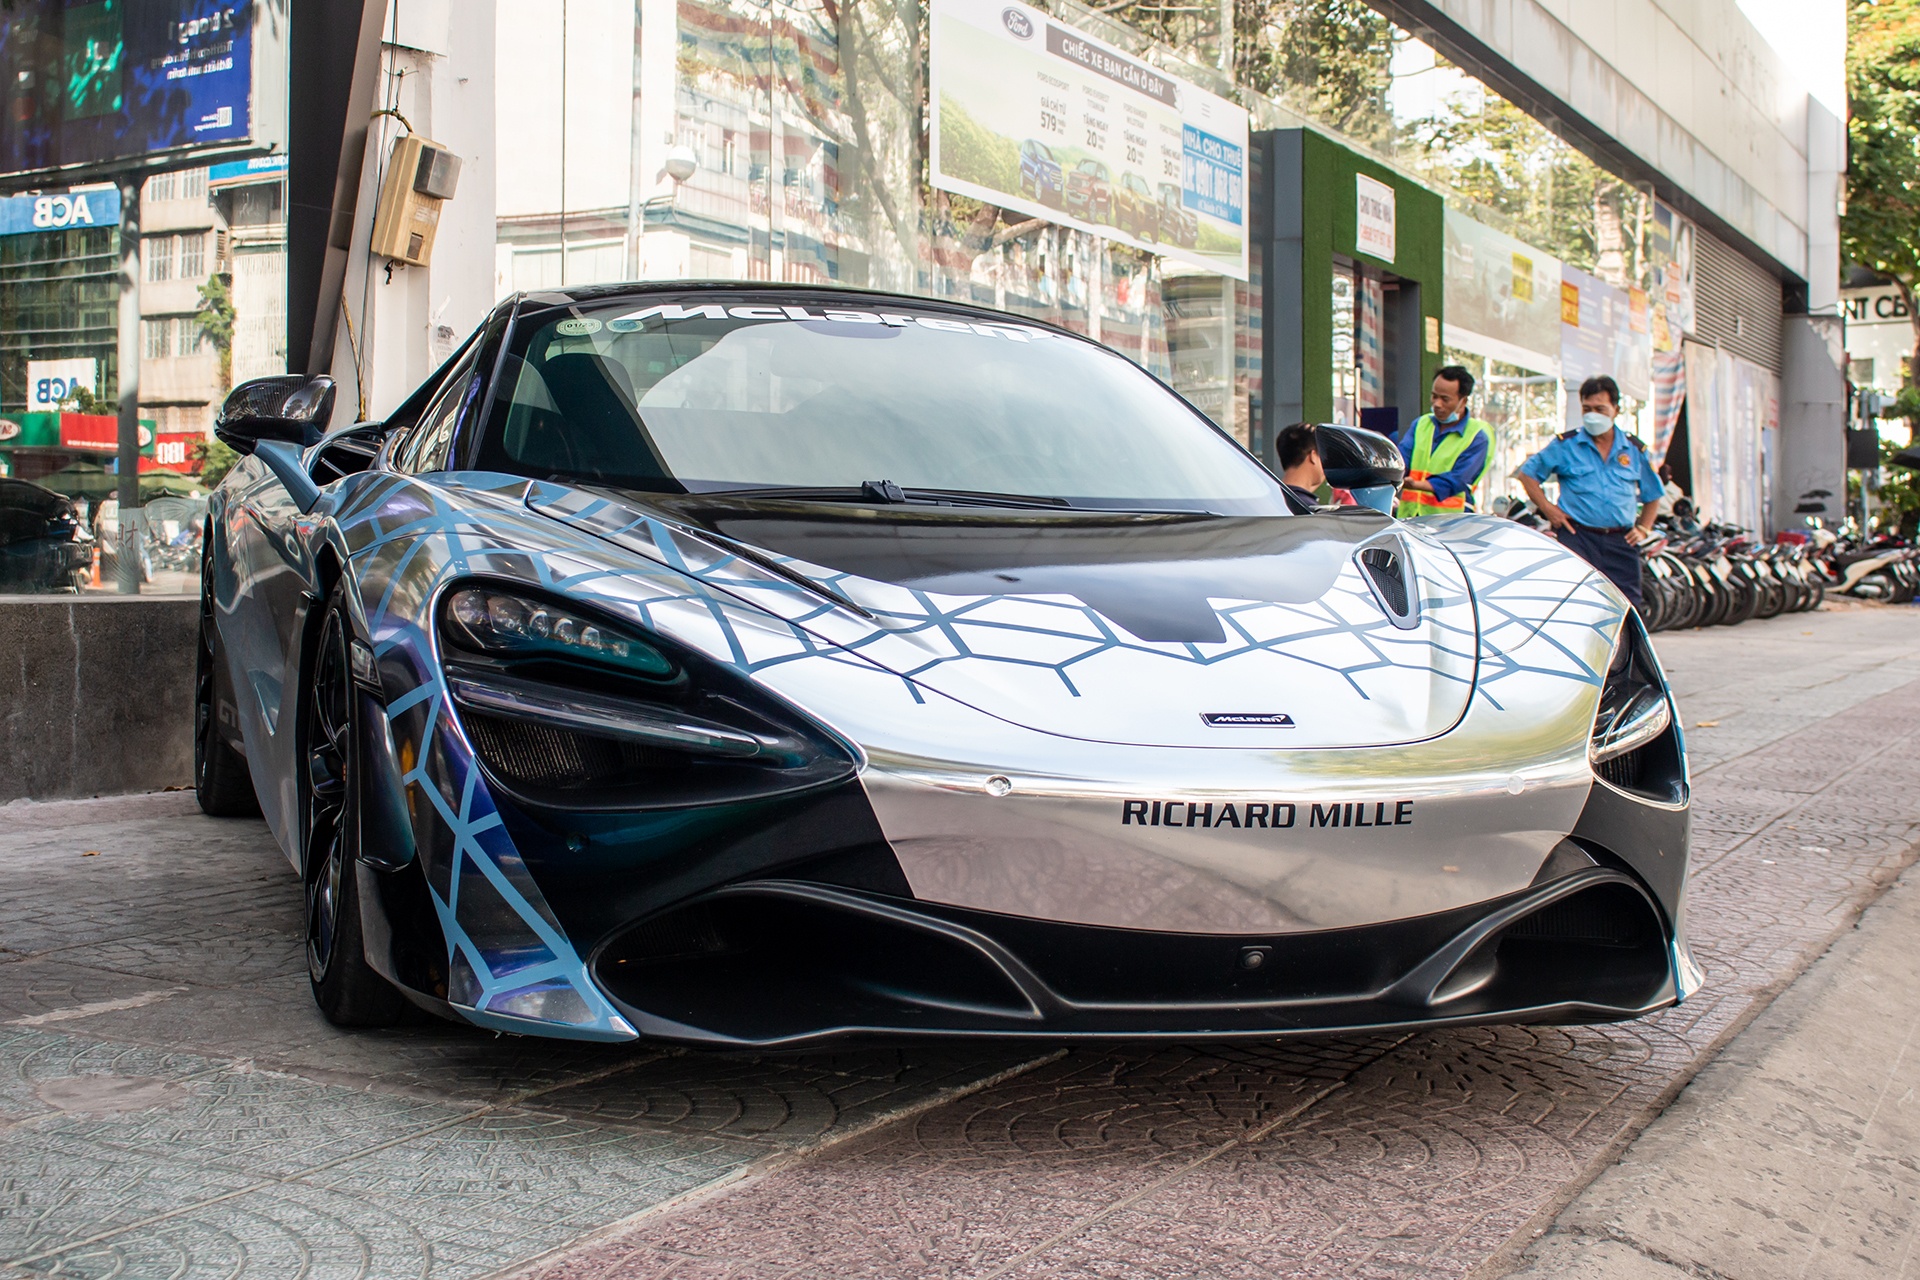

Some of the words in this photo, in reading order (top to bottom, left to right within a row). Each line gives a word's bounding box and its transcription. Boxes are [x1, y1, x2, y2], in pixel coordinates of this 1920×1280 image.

[1007, 12, 1029, 37] Ford
[1062, 38, 1089, 63] CHIẾC
[1091, 52, 1103, 69] XE
[1104, 57, 1122, 79] BẠN
[1122, 65, 1140, 87] CẦN
[1148, 77, 1164, 97] ĐÂY
[1040, 111, 1057, 132] 579
[1086, 129, 1097, 148] 20
[1184, 129, 1202, 152] NHÀ
[1202, 138, 1222, 160] CHO
[1222, 146, 1242, 168] THUÊ
[1126, 145, 1137, 163] 20
[1163, 159, 1173, 176] 30
[614, 304, 1054, 343] McLaren
[1214, 714, 1284, 723] McLaren
[1122, 799, 1296, 828] RICHARD
[1309, 800, 1414, 828] MILLE
